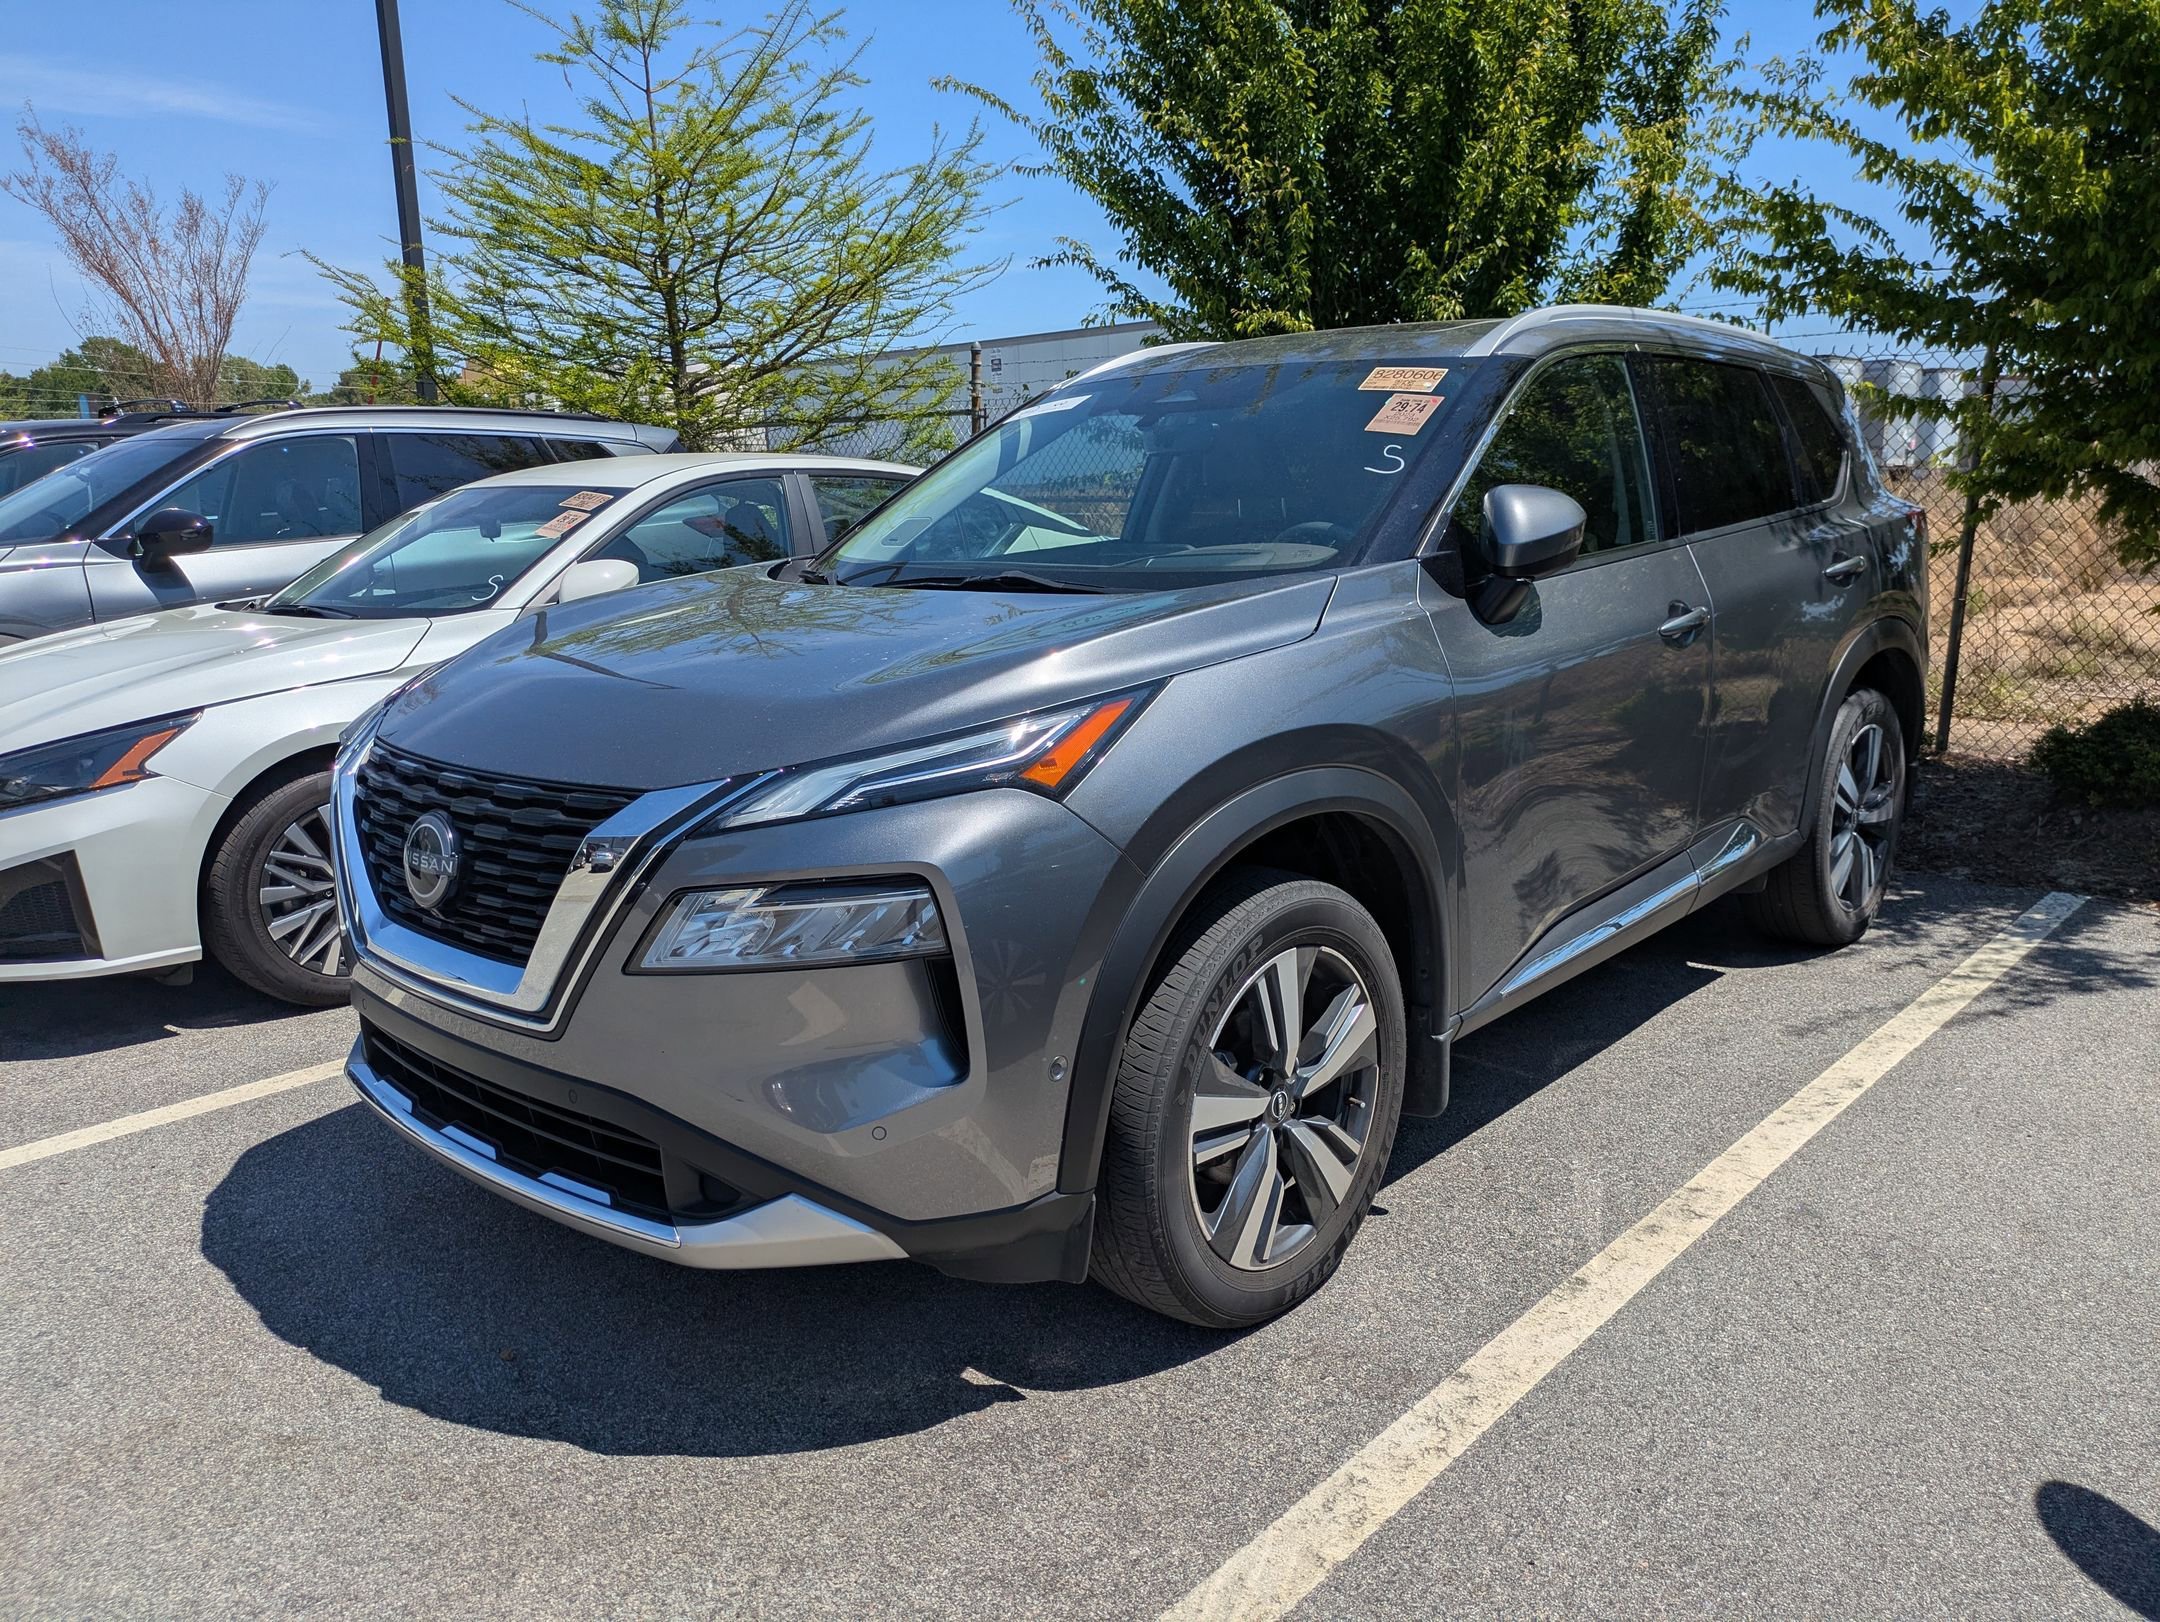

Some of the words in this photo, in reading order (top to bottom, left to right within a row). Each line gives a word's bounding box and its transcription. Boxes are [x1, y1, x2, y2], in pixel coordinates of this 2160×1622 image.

[1364, 444, 1405, 474] S
[471, 574, 504, 601] S
[1183, 932, 1265, 1076] DUNLOP
